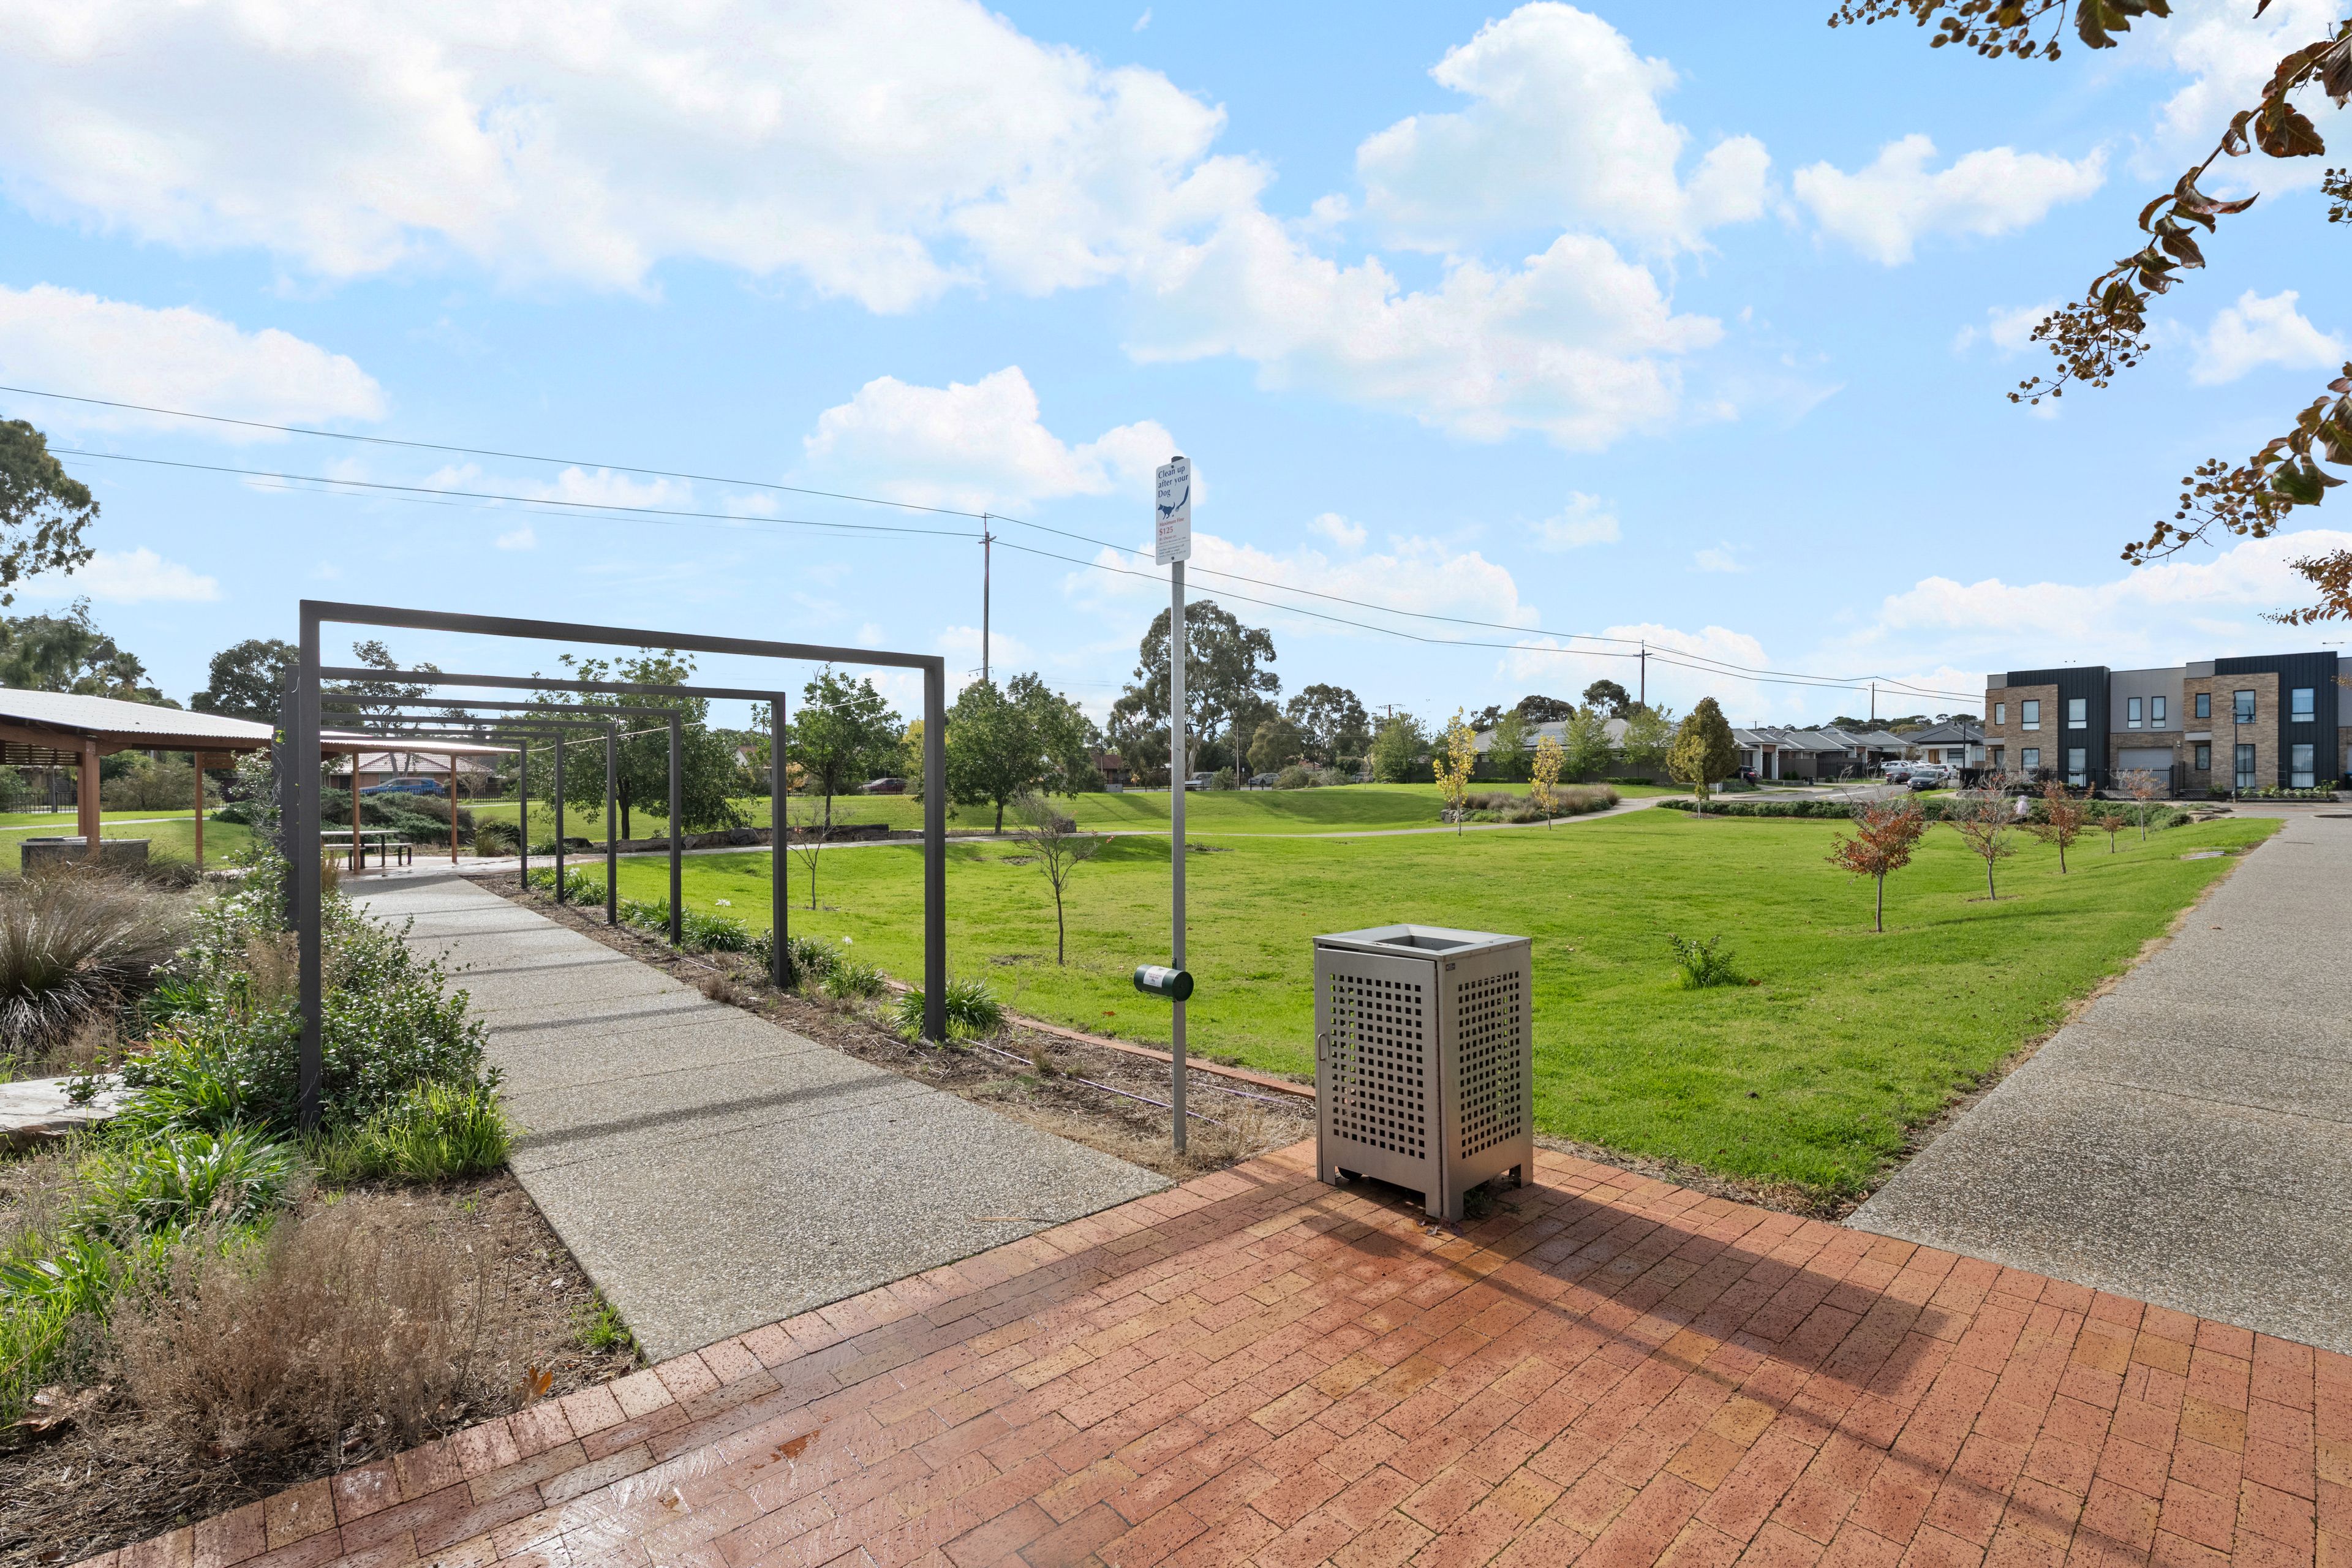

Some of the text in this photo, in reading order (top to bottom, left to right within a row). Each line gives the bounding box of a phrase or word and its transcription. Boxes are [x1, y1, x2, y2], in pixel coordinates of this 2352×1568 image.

[1158, 466, 1185, 479] Clean up
[1158, 474, 1188, 489] after your
[1158, 489, 1171, 498] Dog
[1159, 526, 1174, 536] $125
